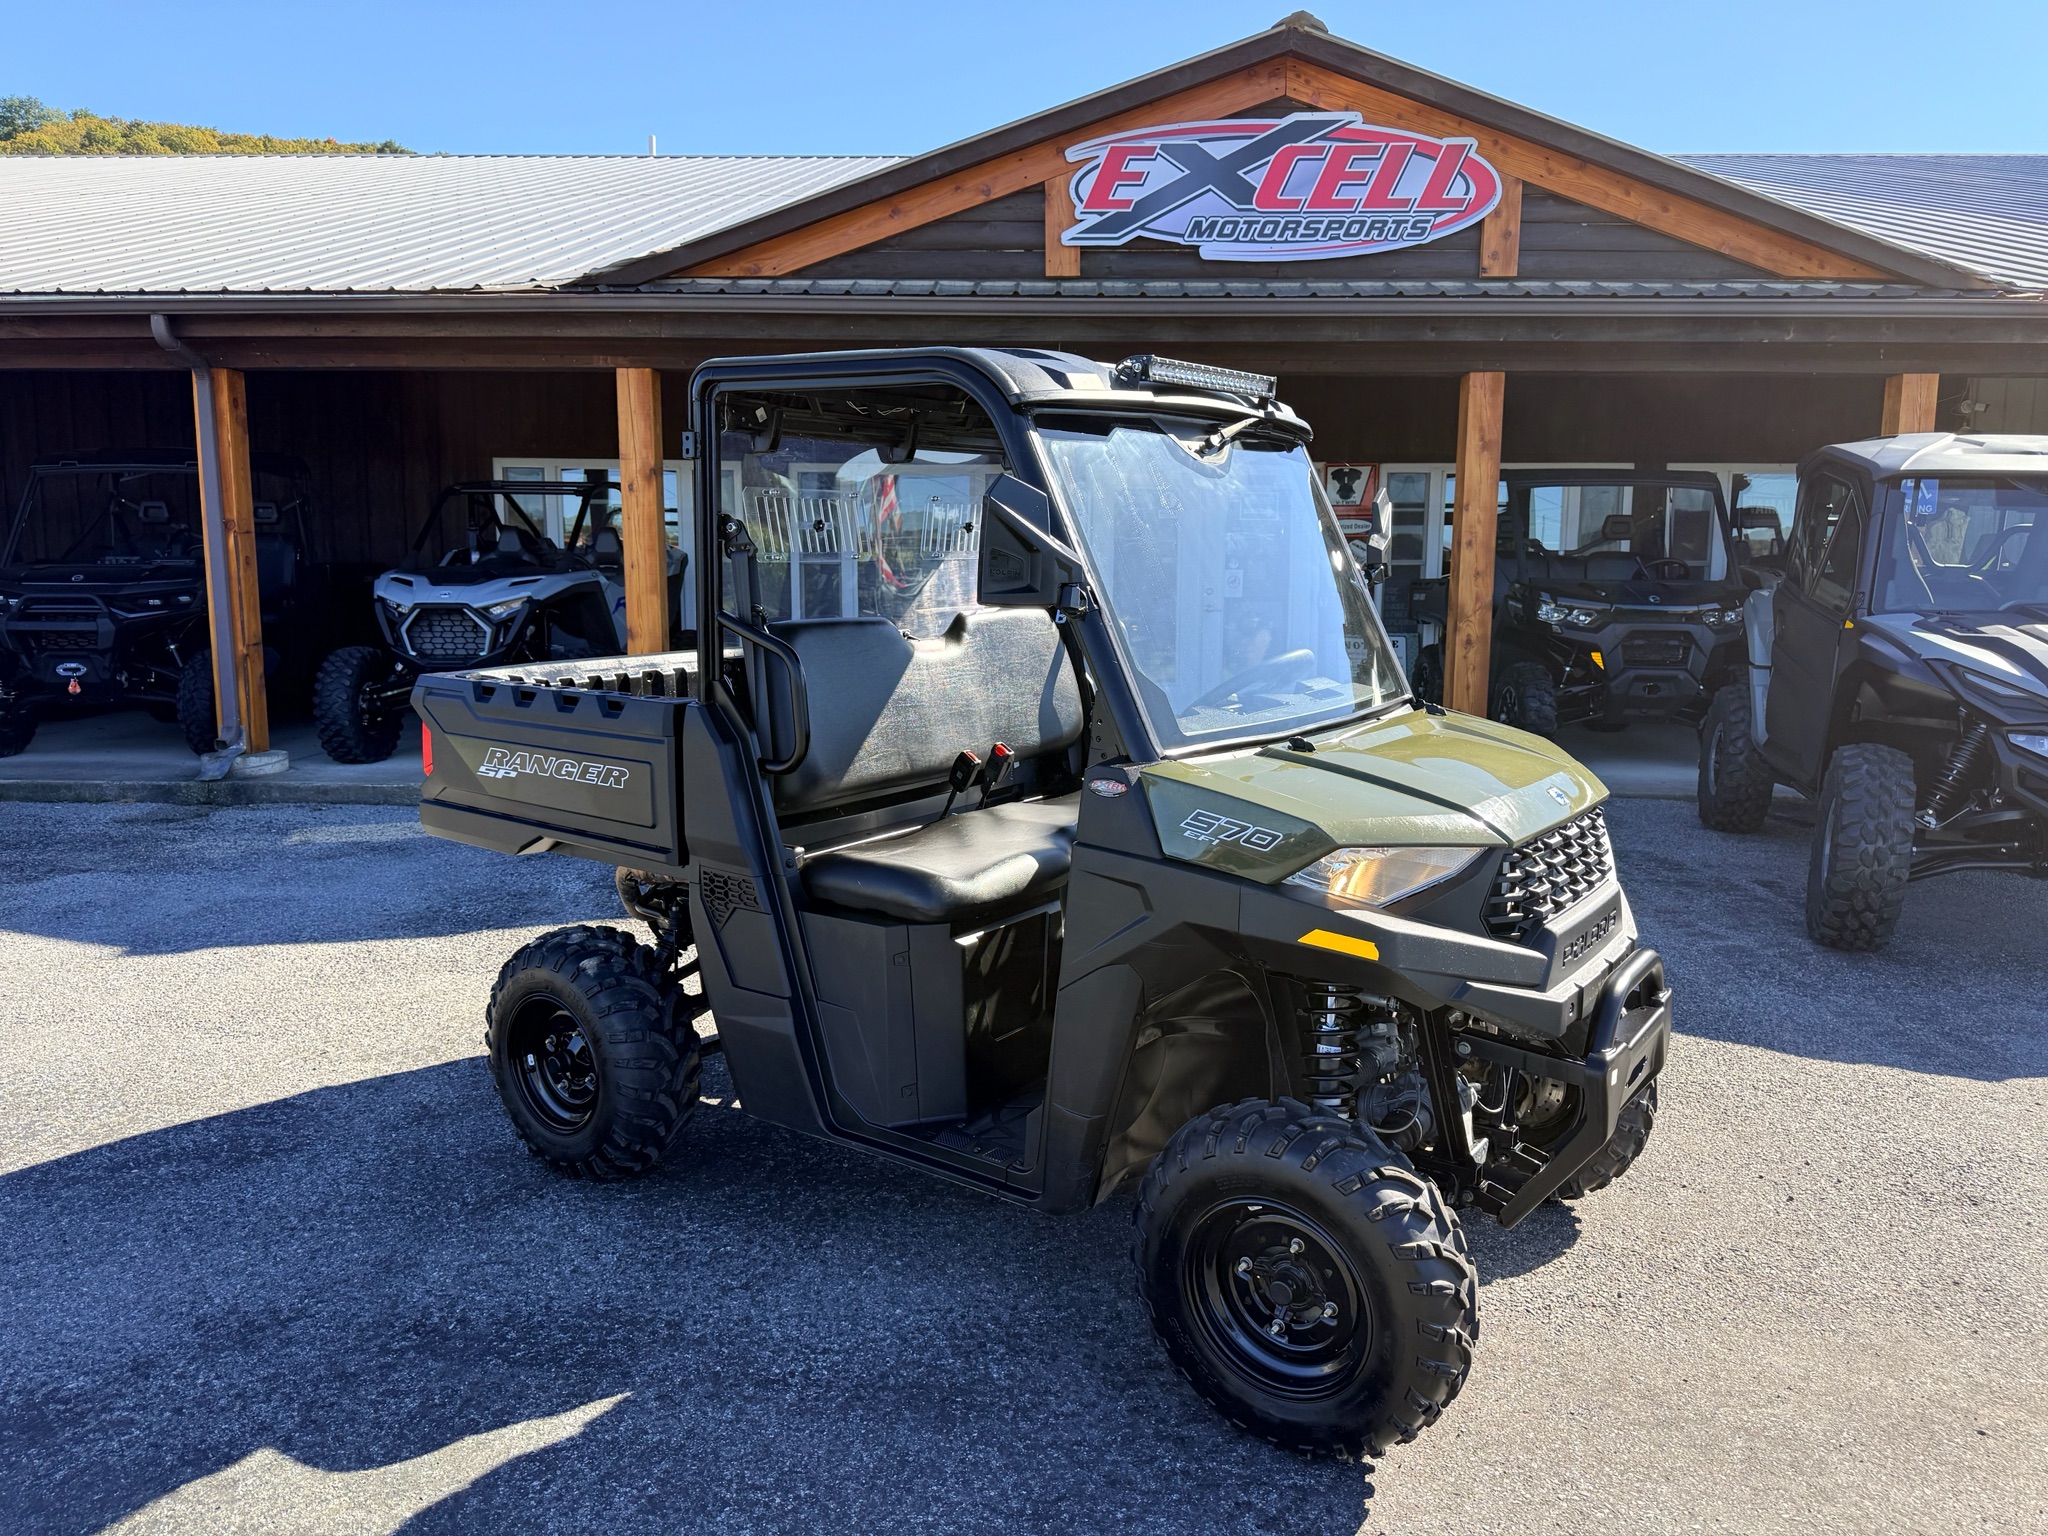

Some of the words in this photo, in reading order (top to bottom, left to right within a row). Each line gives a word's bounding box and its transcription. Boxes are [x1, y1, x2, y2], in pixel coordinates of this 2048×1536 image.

[1067, 119, 1470, 239] EXCELL
[1186, 216, 1434, 242] MOTORSPORTS
[476, 765, 518, 779] SP
[483, 747, 629, 789] RANGER
[1179, 808, 1284, 852] 570
[1183, 830, 1220, 846] EFI
[1562, 907, 1617, 969] POLARIS
